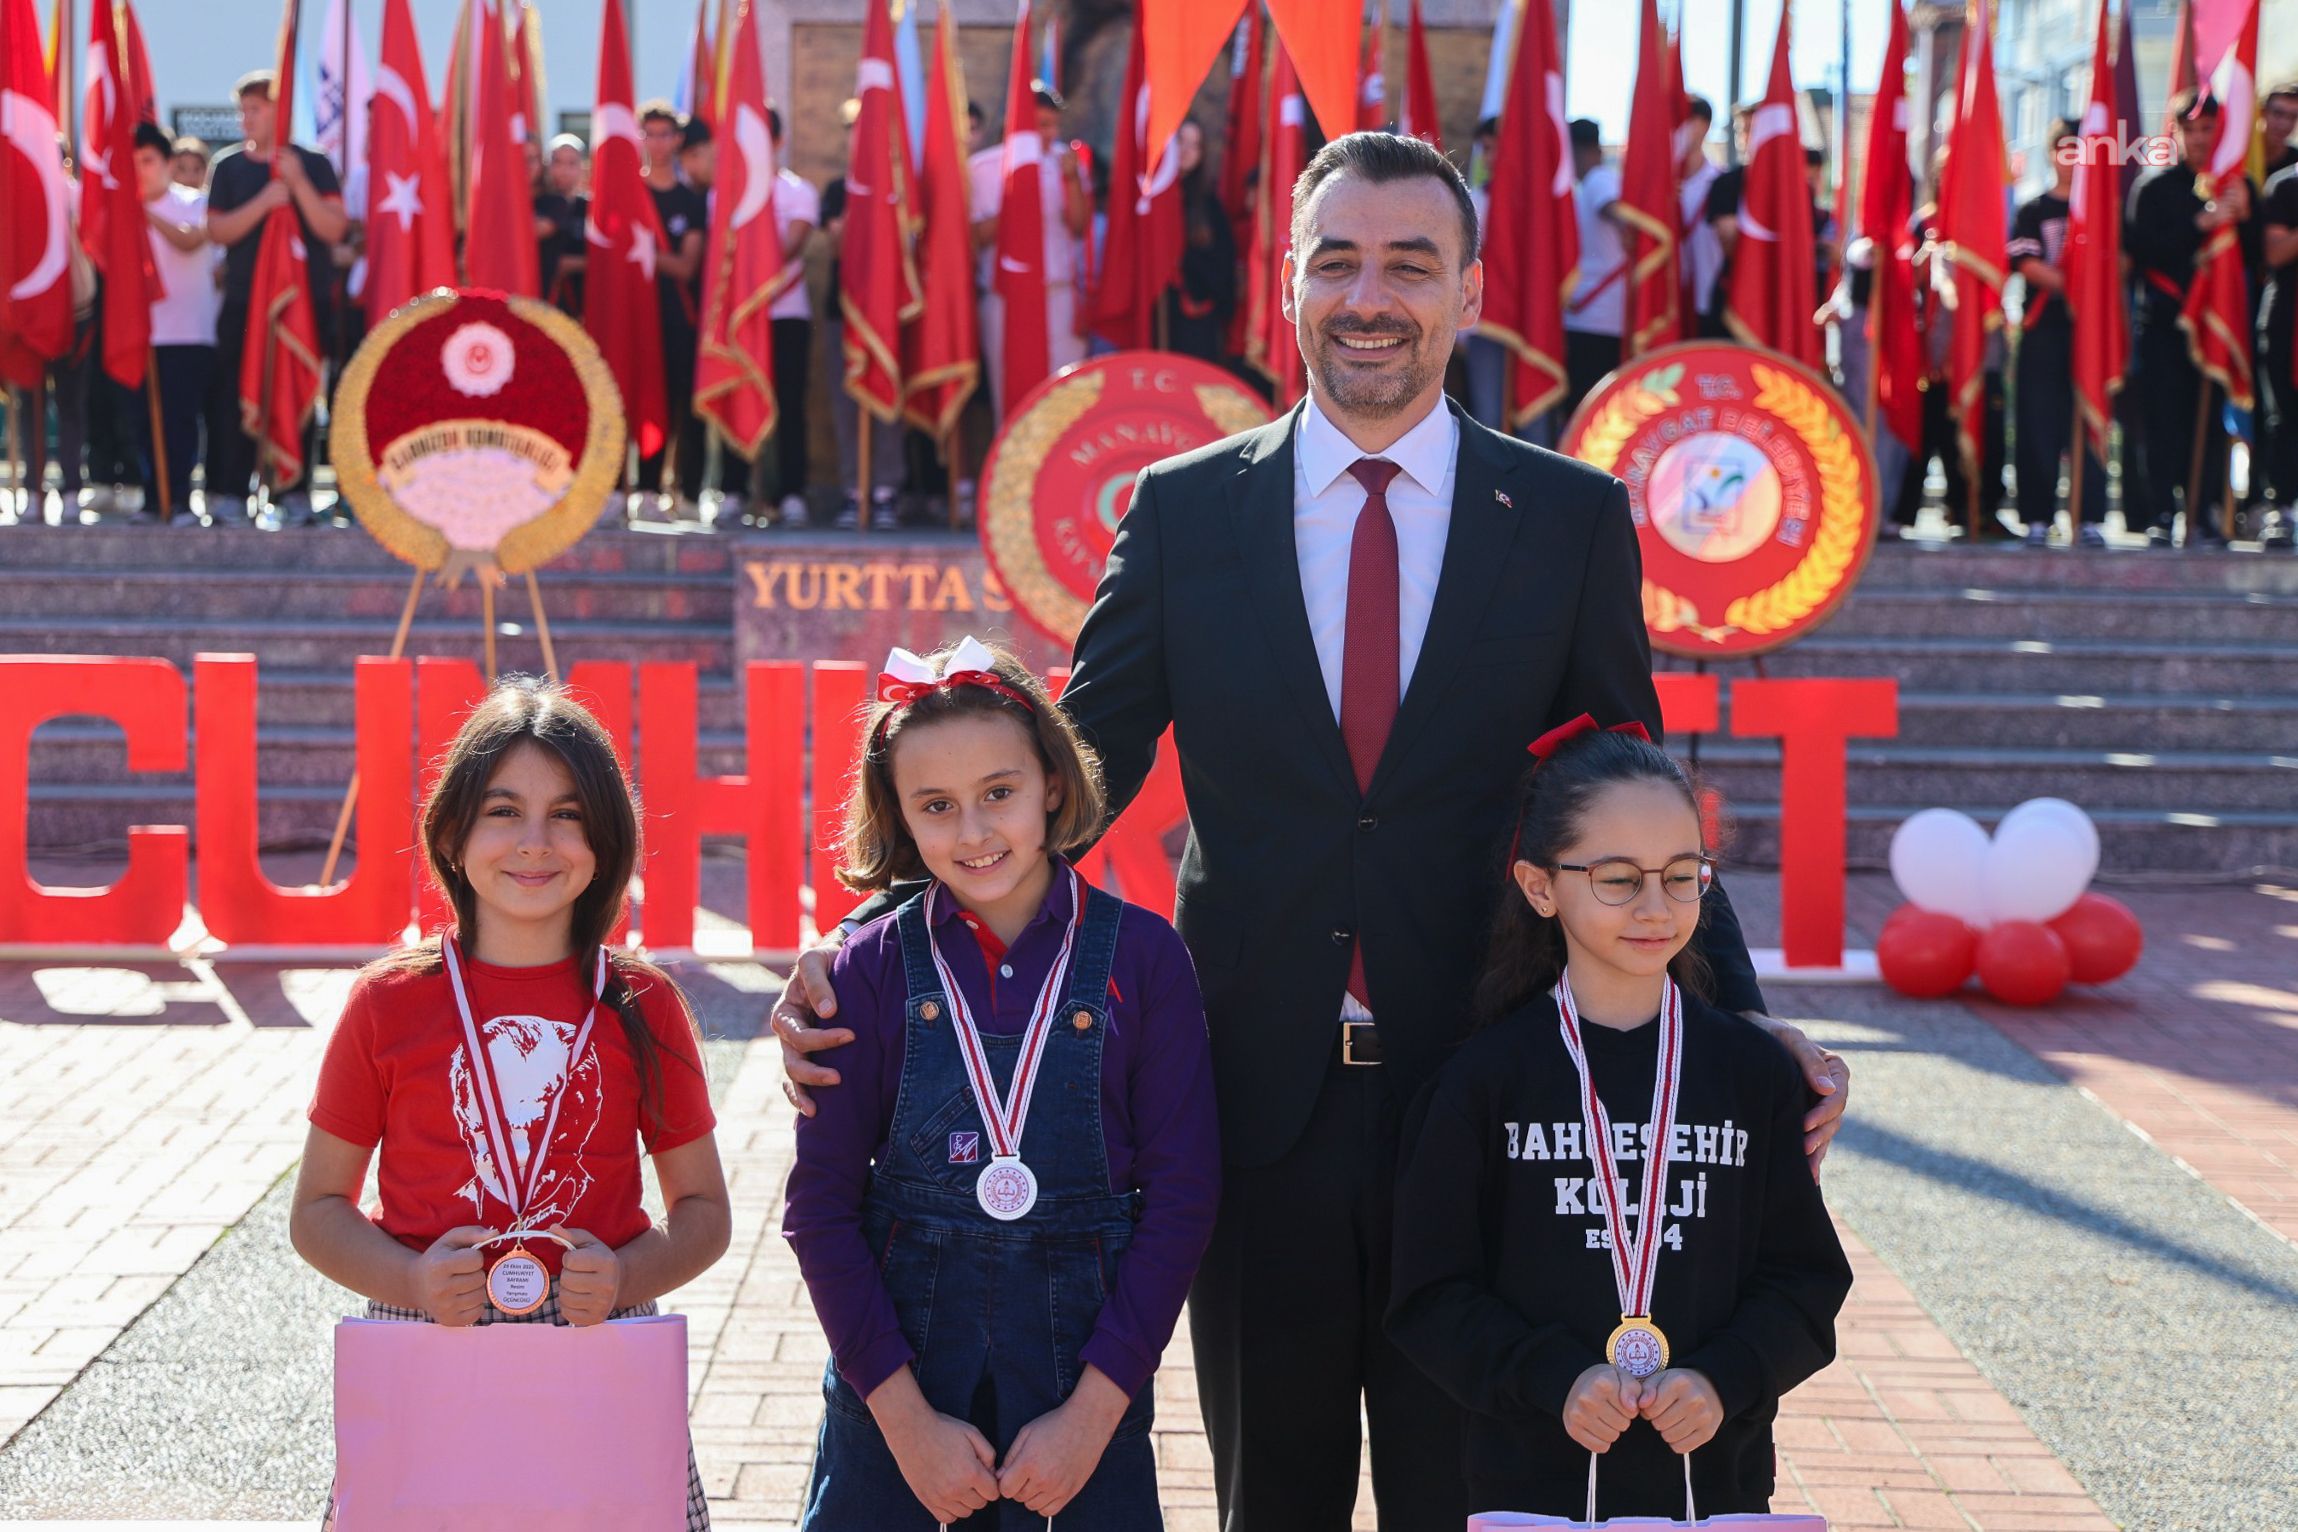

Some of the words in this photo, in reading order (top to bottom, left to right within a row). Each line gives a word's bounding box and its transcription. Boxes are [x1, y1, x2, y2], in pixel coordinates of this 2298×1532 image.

[746, 561, 975, 612] YURTTA
[1504, 1120, 1748, 1167] BAHEEHİR
[1554, 1172, 1707, 1218] KOLJİ
